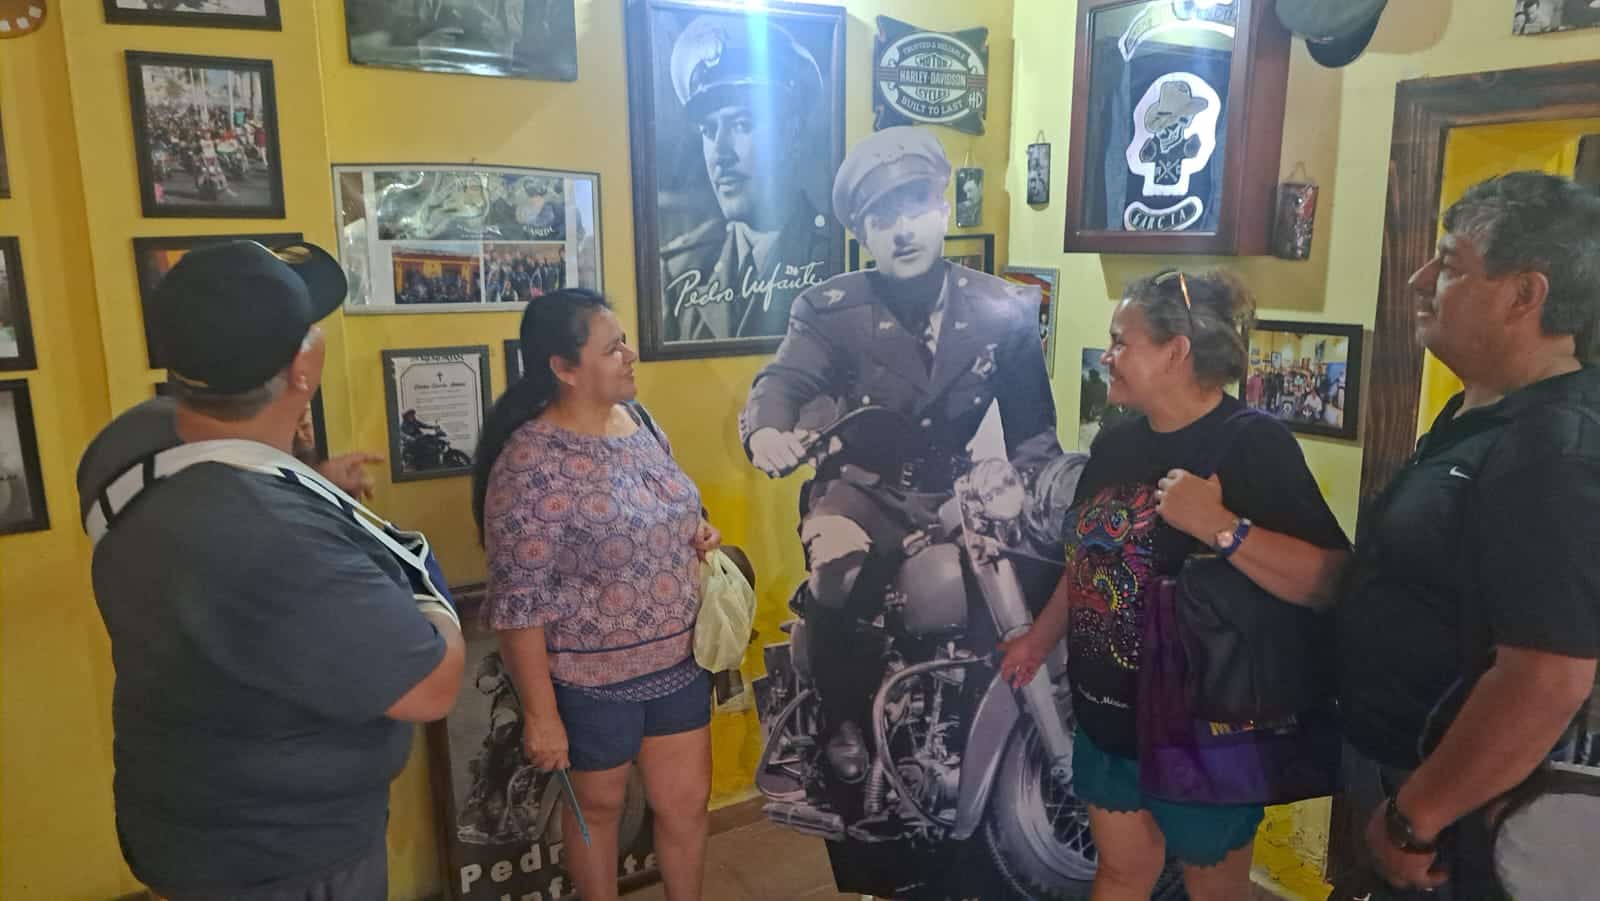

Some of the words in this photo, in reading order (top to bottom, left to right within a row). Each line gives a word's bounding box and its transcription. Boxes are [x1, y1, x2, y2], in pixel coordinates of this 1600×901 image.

[899, 70, 966, 87] HARLEY-DAVIDSON
[901, 96, 927, 113] BUILT
[928, 105, 940, 115] TO
[941, 99, 963, 113] LAST
[667, 269, 735, 317] Pedro
[741, 261, 826, 312] Infante
[460, 842, 564, 895] Pedr
